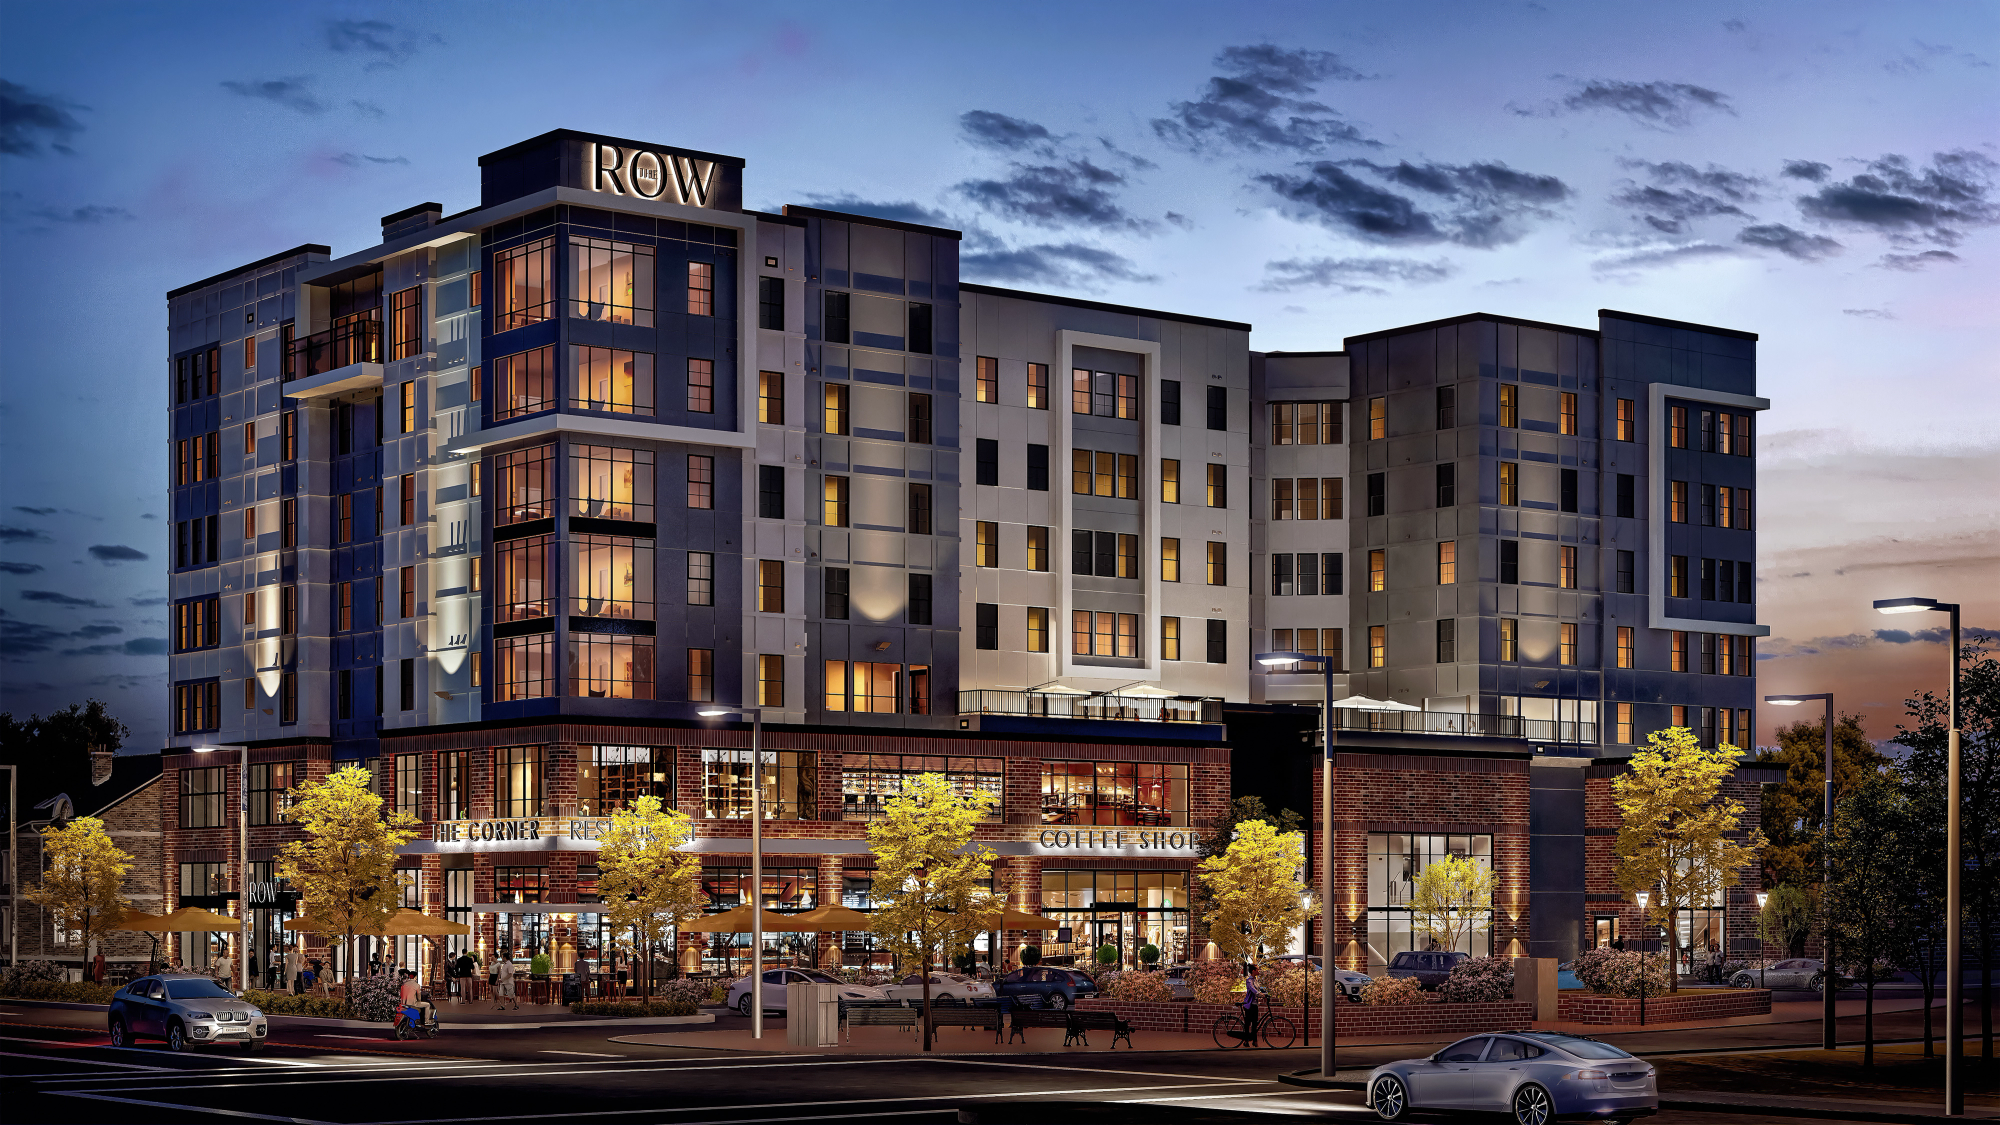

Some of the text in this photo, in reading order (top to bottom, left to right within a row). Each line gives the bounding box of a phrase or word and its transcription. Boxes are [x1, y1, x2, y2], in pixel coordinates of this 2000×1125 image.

[593, 142, 716, 206] ROW
[431, 820, 540, 843] THE CORNER
[1039, 829, 1200, 850] COFFEE SHOP
[249, 881, 277, 904] ROW
